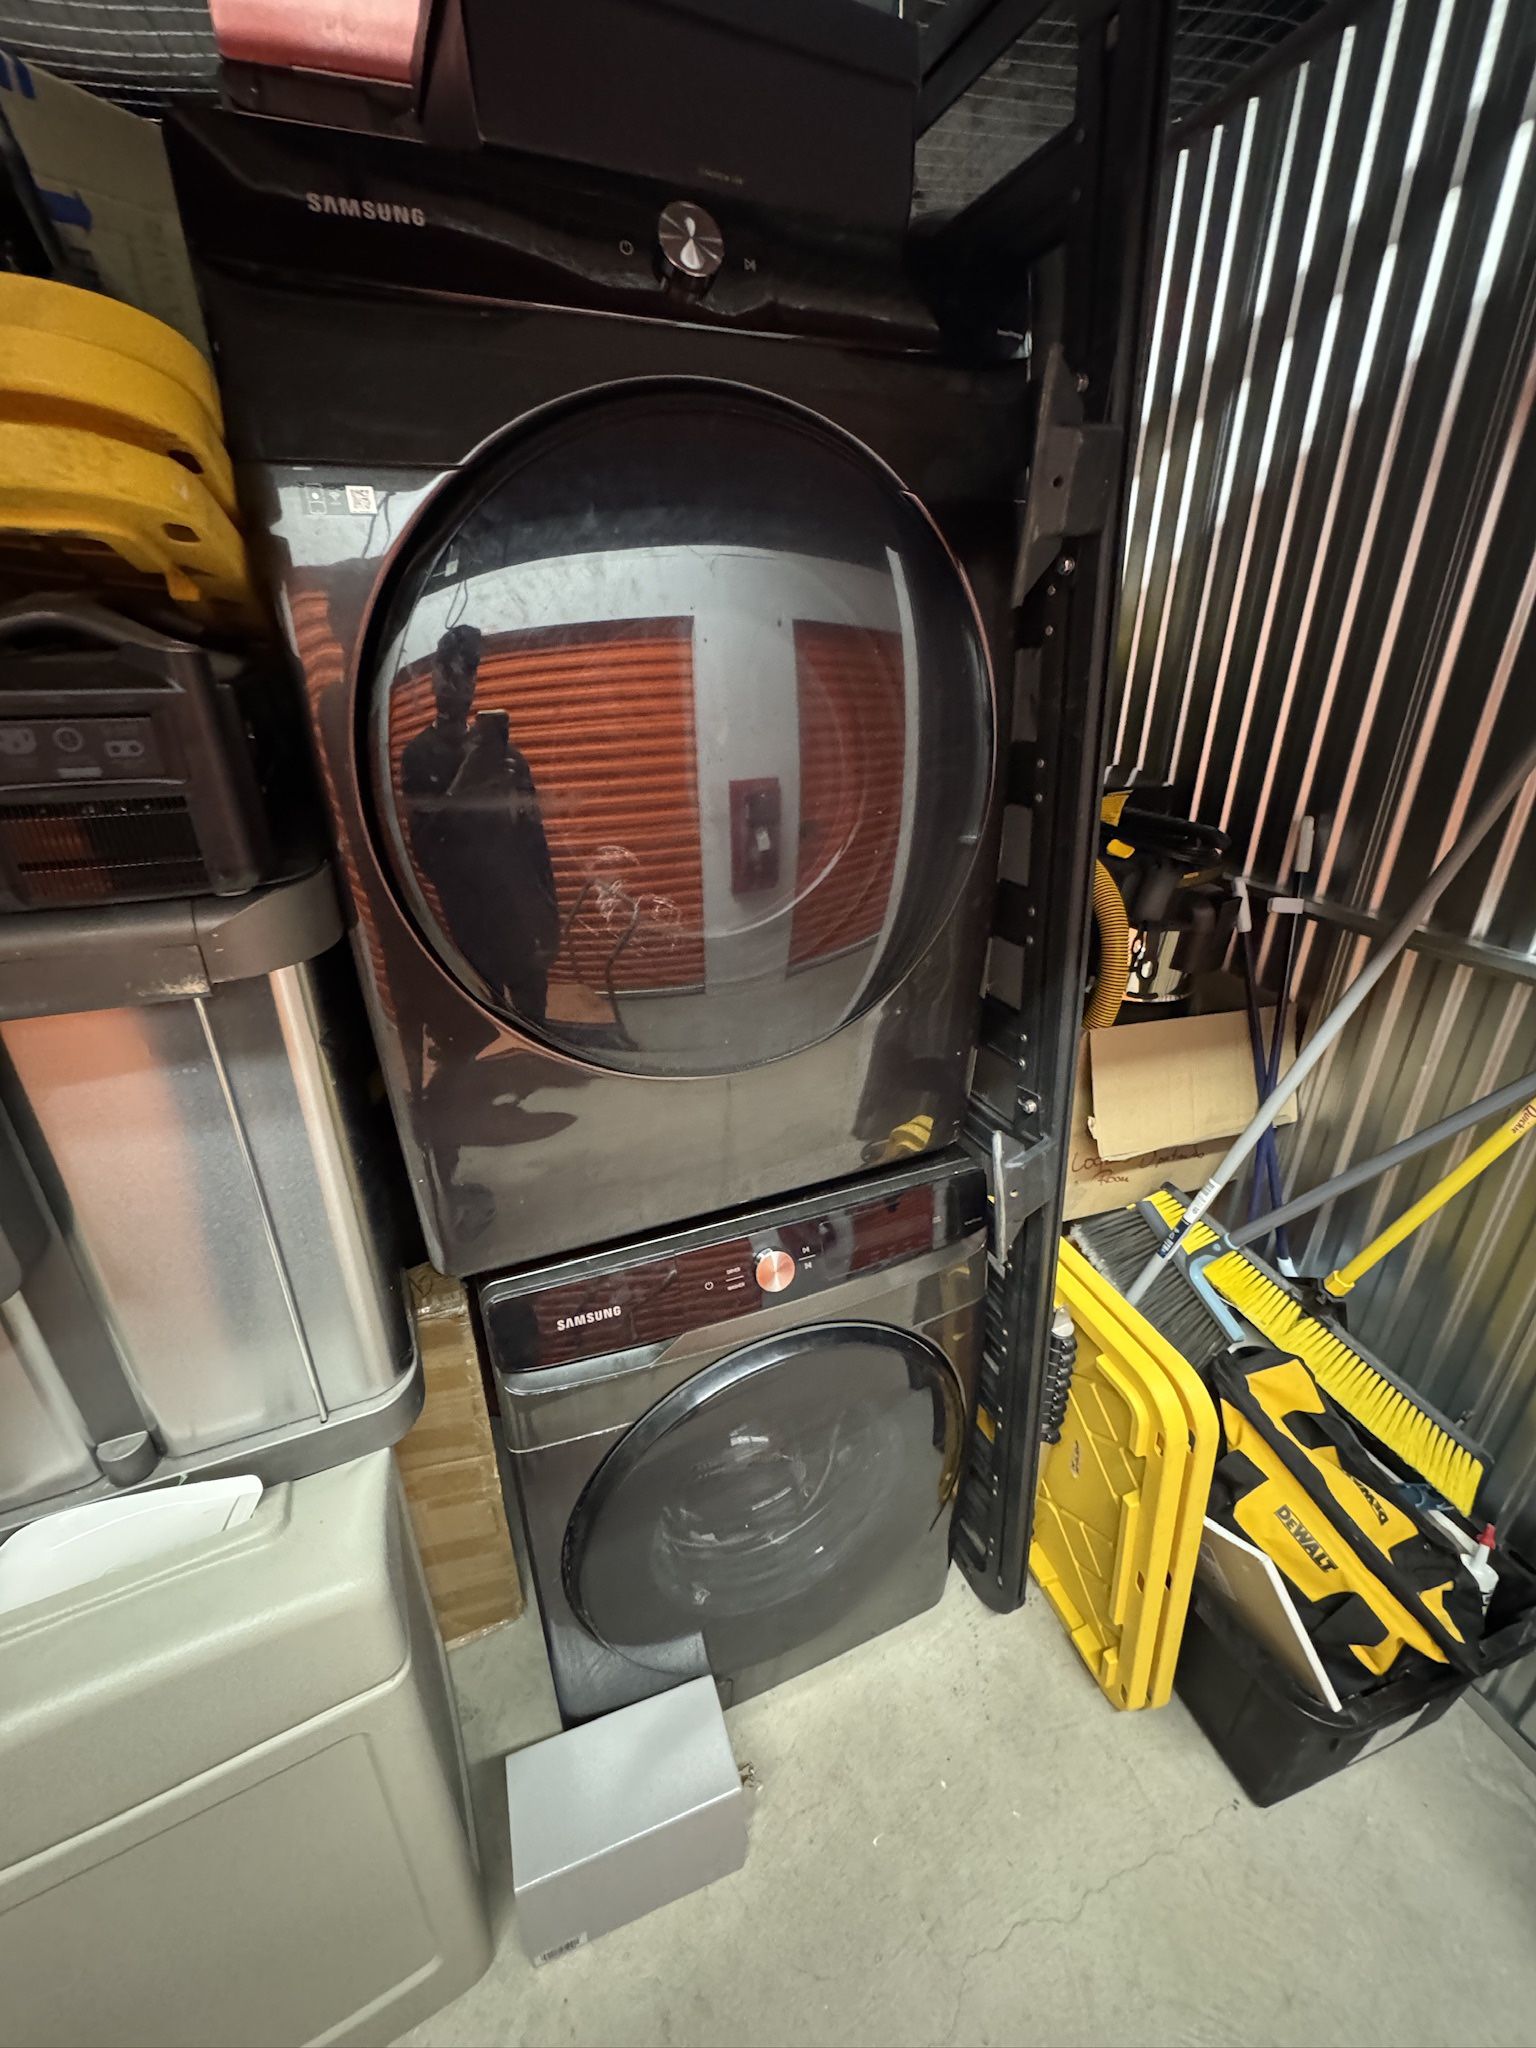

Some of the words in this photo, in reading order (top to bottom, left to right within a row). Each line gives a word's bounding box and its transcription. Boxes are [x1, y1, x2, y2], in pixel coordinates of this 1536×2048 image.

[306, 192, 426, 228] SAMSUNG
[556, 1305, 622, 1332] SAMSUNG
[1274, 1504, 1339, 1573] DEWALT
